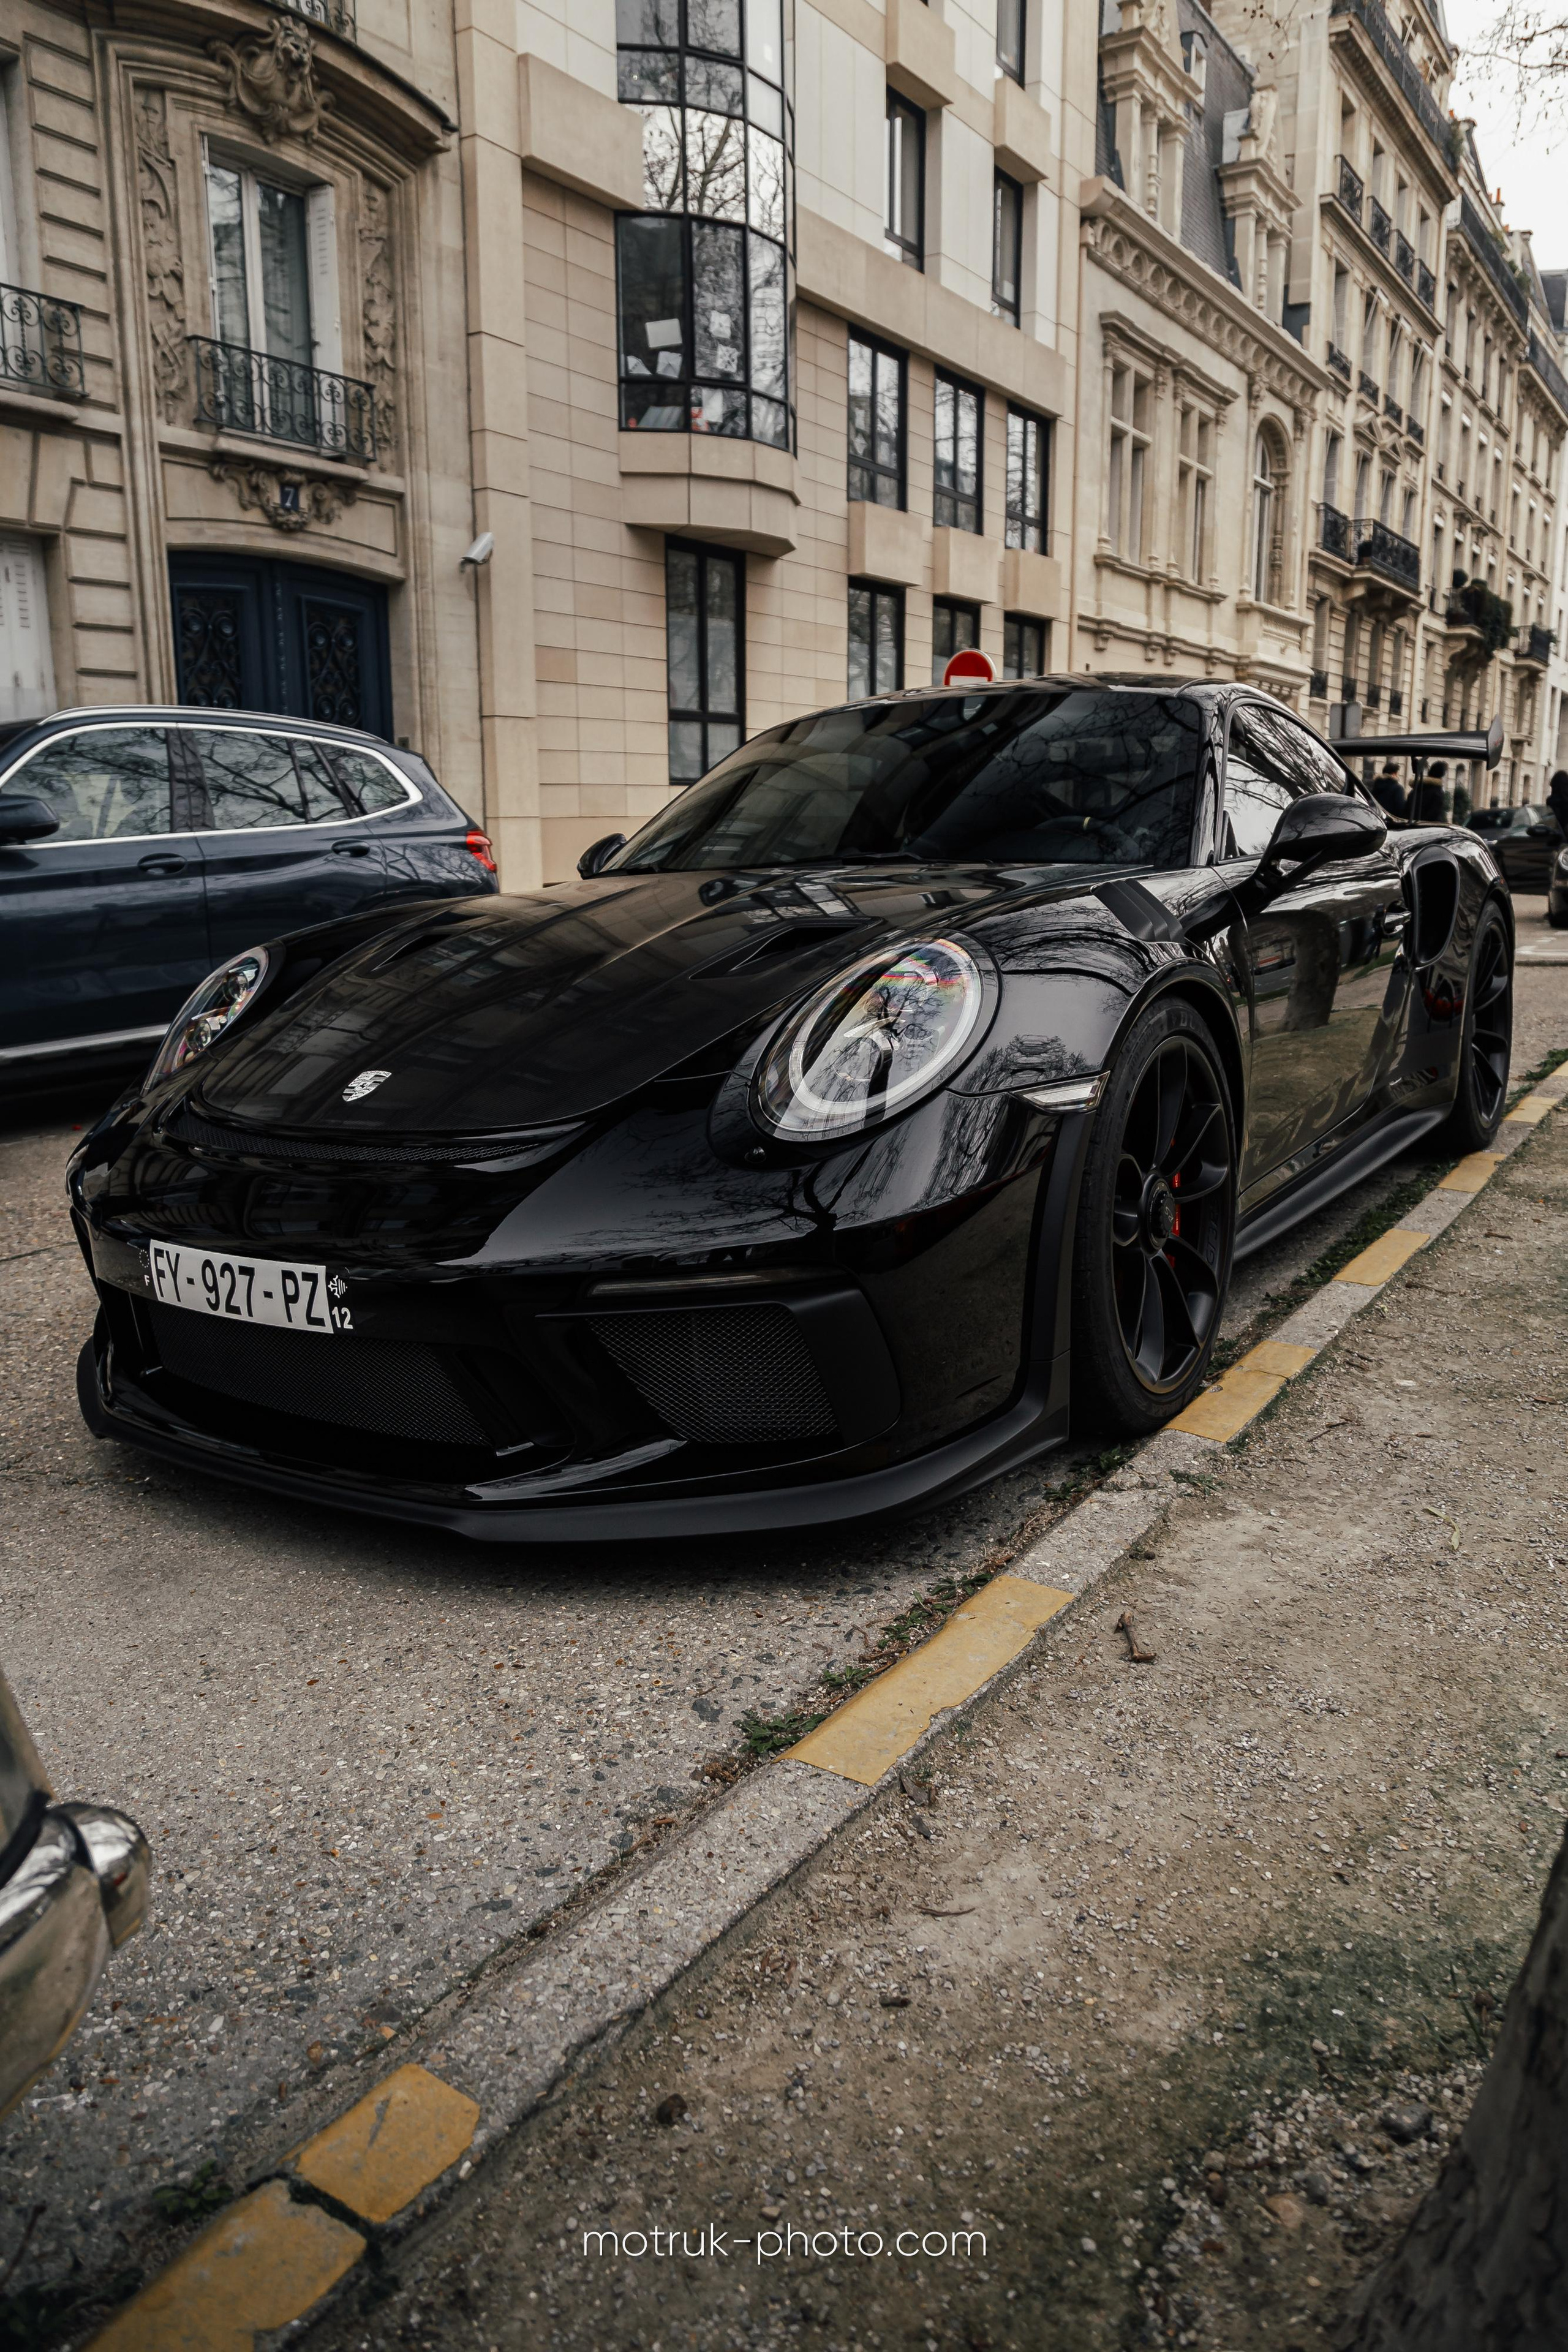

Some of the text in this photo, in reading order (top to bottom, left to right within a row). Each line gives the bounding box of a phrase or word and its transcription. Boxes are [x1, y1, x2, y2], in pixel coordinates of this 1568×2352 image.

[284, 486, 295, 507] 7
[144, 1274, 150, 1286] F
[153, 1247, 326, 1327] FY-927-PZ
[331, 1306, 353, 1330] 12
